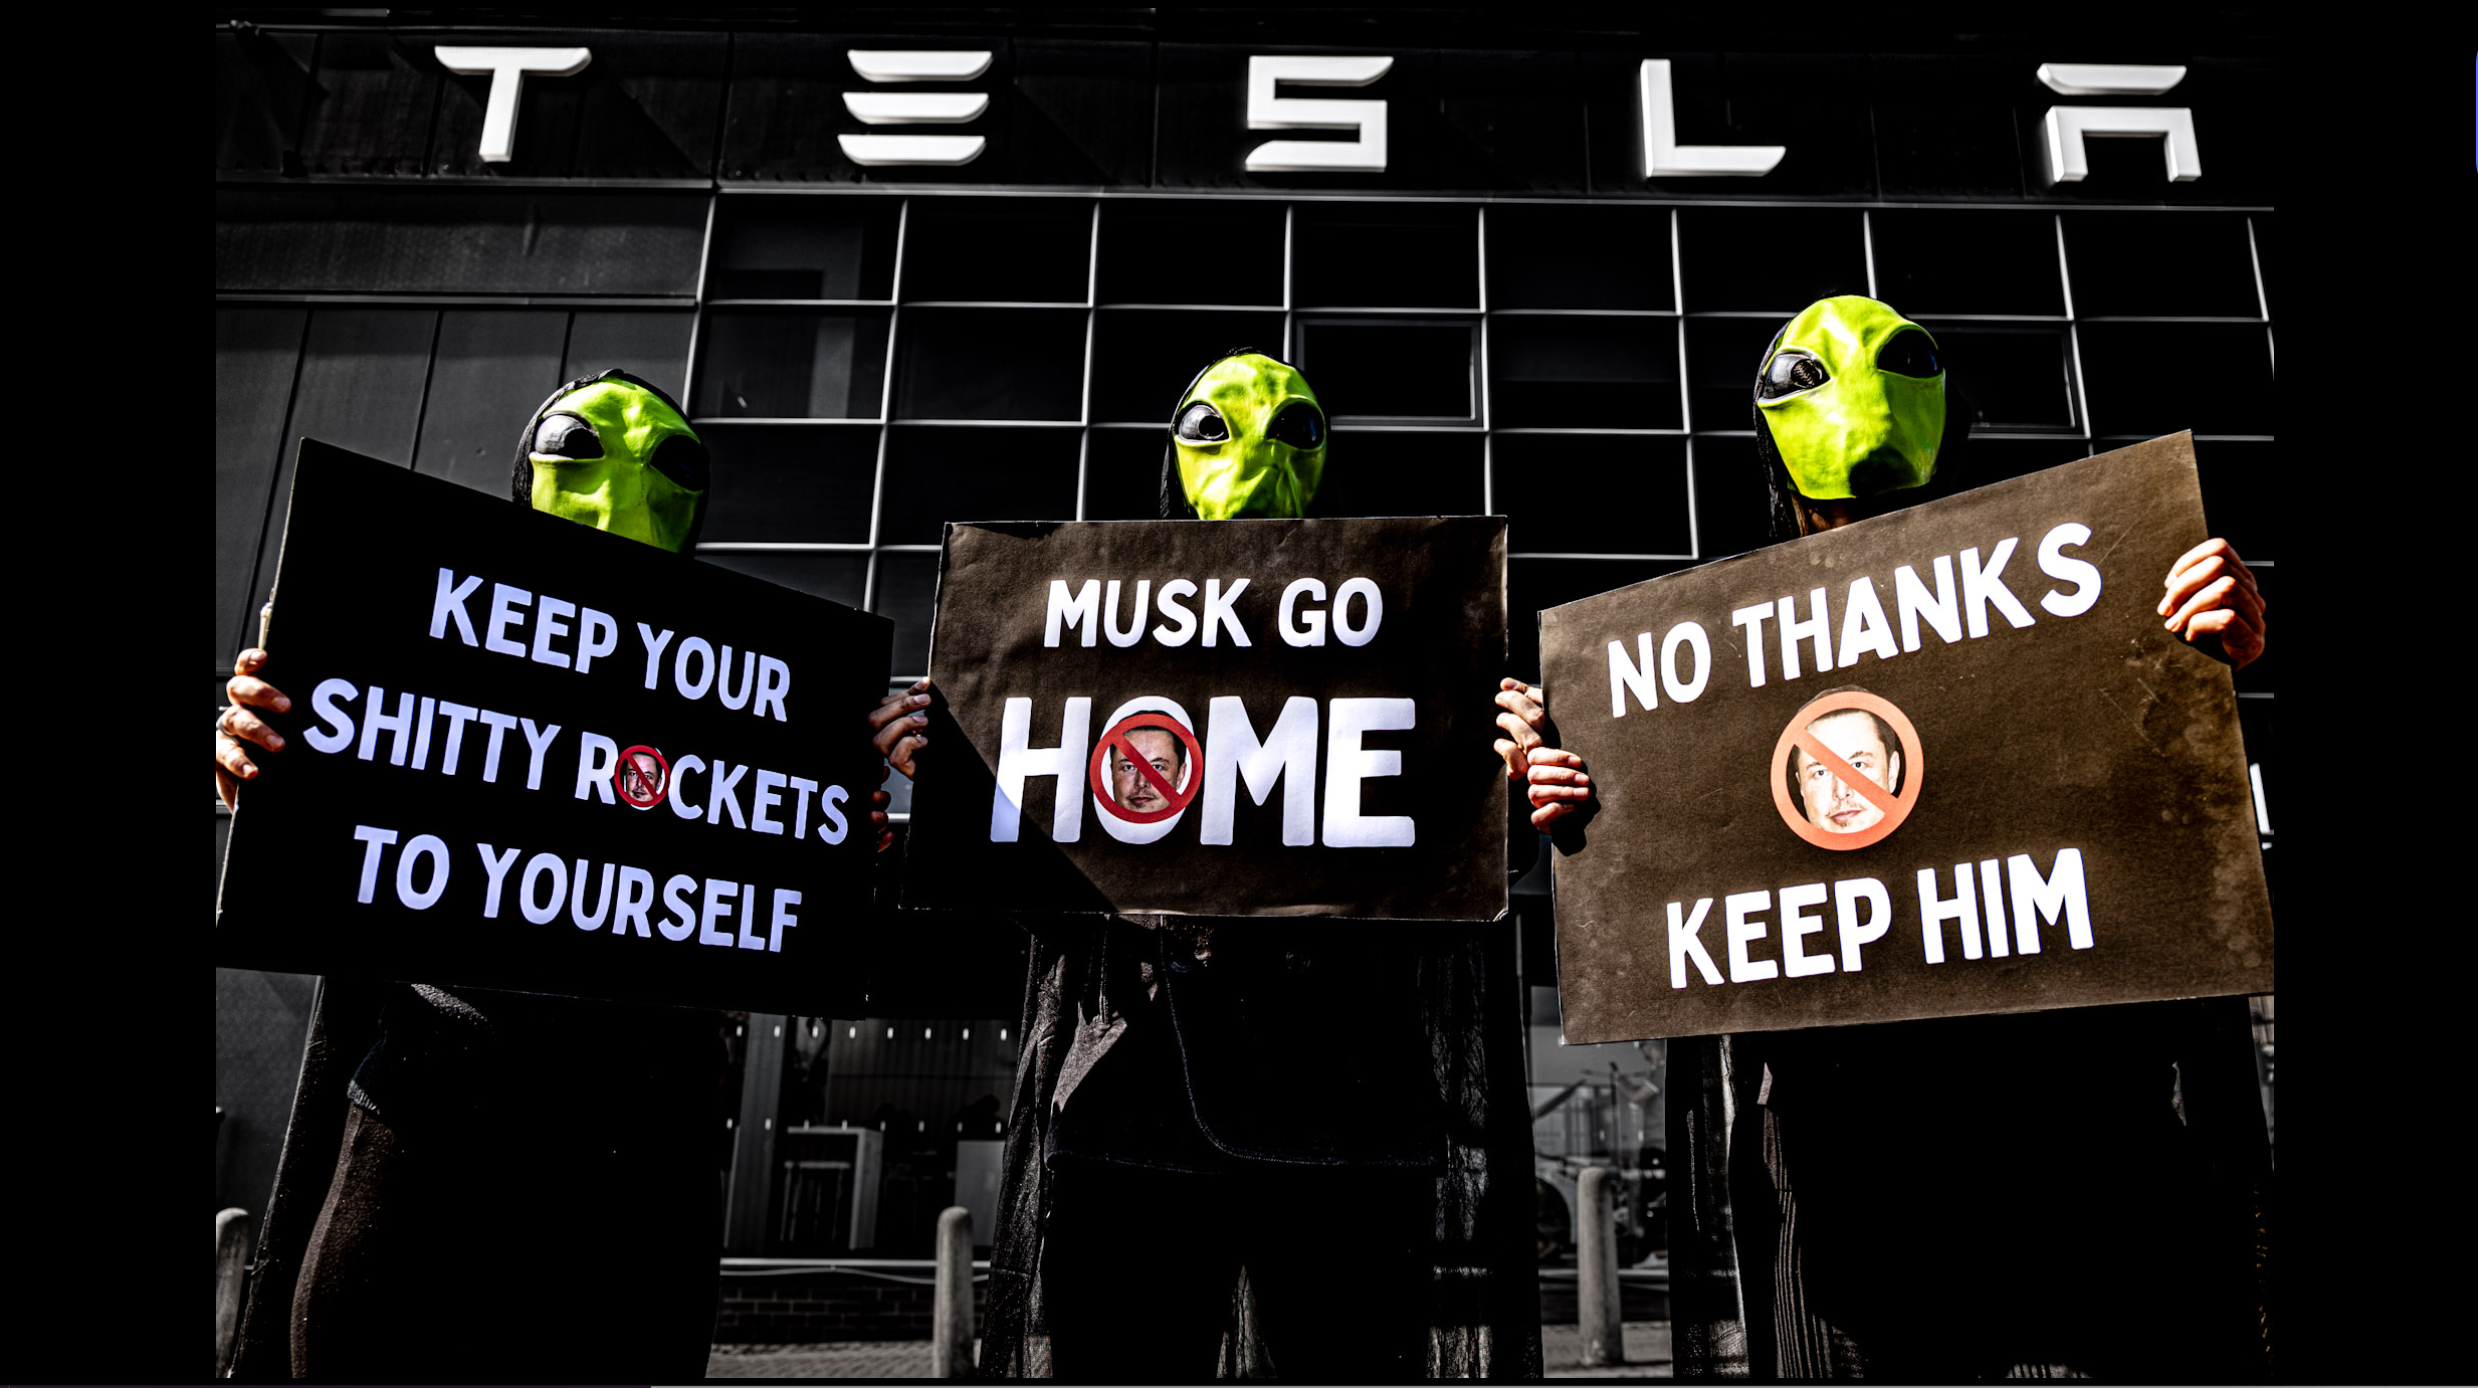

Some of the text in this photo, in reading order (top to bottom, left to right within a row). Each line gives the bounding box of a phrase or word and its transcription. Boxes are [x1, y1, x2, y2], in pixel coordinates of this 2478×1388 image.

[433, 45, 2202, 184] TESLA
[428, 567, 790, 722] KEEP YOUR
[1043, 577, 1383, 648] MUSK GO
[1607, 522, 2102, 718] NO THANKS
[302, 678, 850, 845] SHITTY RCKETS
[990, 695, 1416, 848] HOME
[353, 824, 802, 953] TO YOURSELF
[1666, 847, 2094, 989] KEEP HIM
